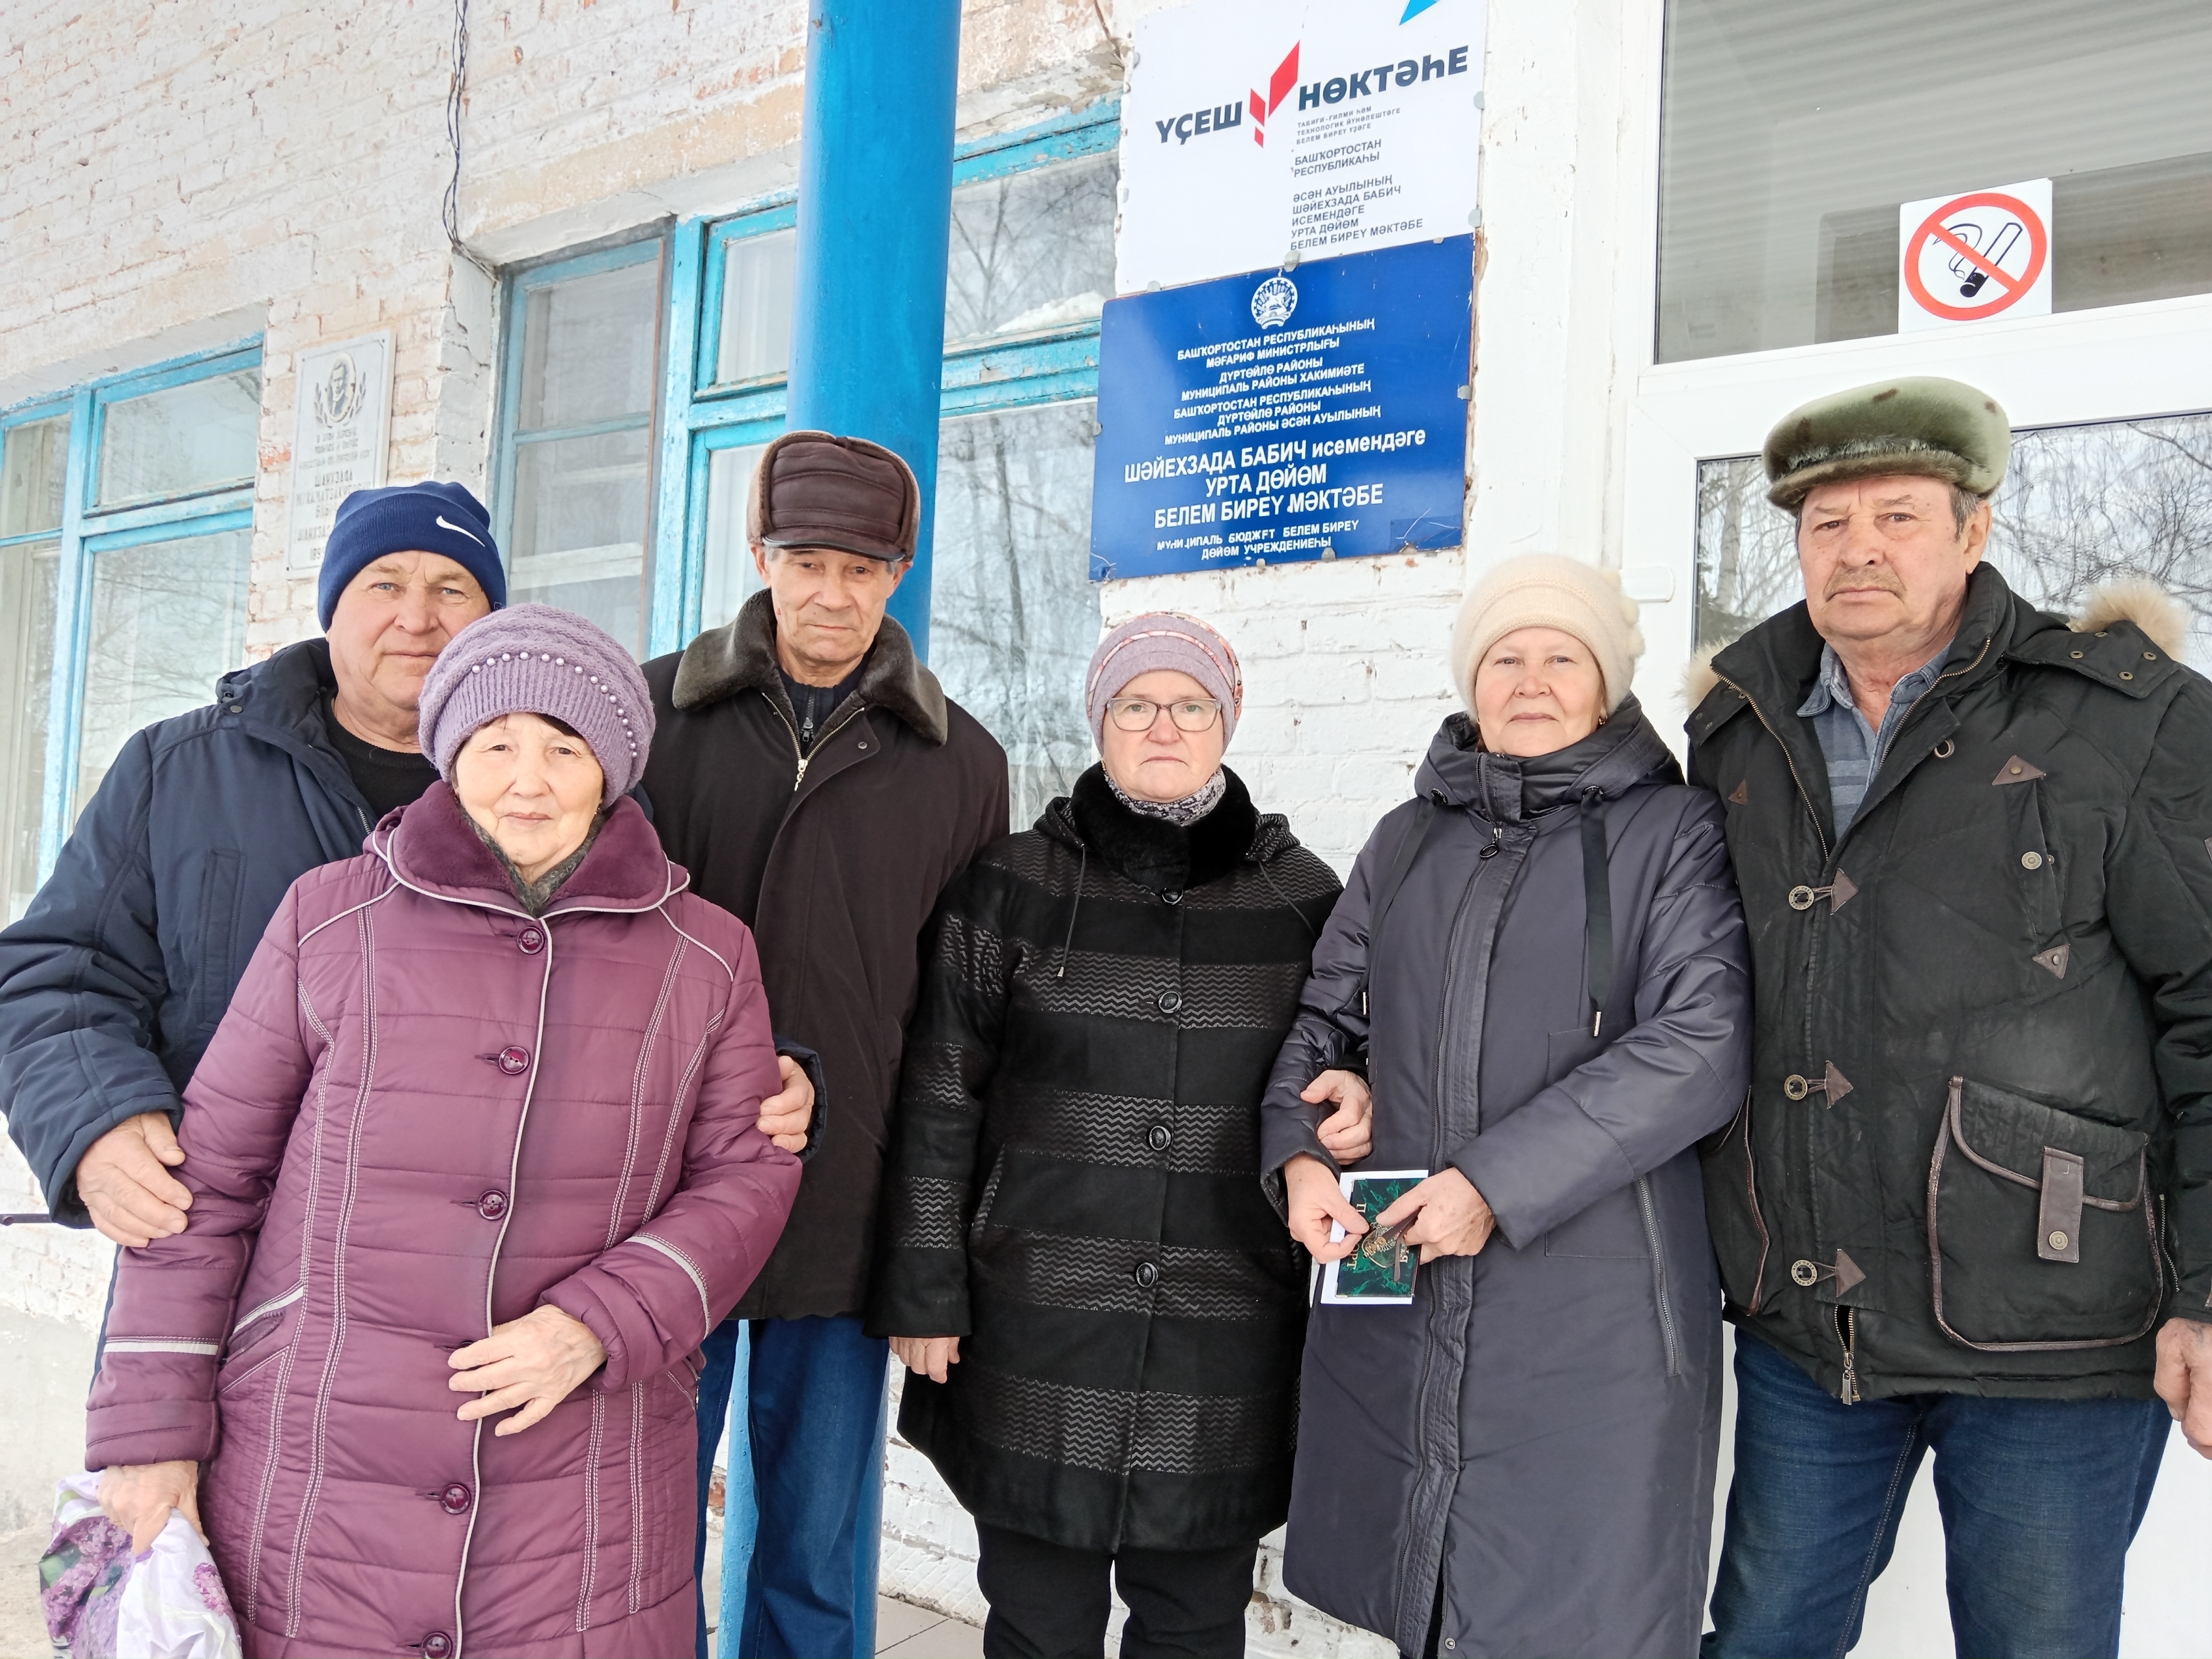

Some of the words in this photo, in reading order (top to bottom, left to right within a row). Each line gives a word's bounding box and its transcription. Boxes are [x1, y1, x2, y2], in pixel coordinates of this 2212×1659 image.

[1297, 121, 1344, 136] ТЕХНОЛОГИК
[1296, 134, 1321, 145] БЕЛЕМ
[1293, 189, 1322, 202] ӘСӘН
[1293, 194, 1360, 214] ШӘЙЕХЗАДА
[1363, 185, 1401, 201] БАБИЧ
[1292, 204, 1365, 226] ИСЕМЕНДӘГЕ
[1290, 236, 1327, 251] БЕЛЕМ
[1370, 218, 1423, 236] МӘКТӘБЕ
[1291, 226, 1316, 239] УРТА
[1319, 218, 1358, 235] ДӨЙӨМ
[1276, 356, 1323, 374] РАЙОНЫ
[1181, 381, 1250, 401] МУНИЦИПАЛЬ
[1252, 373, 1297, 390] РАЙОНЫ
[1274, 400, 1321, 417] РАЙОНЫ
[1164, 427, 1232, 446] МУНИЦИПАЛЬ
[1234, 420, 1279, 436] РАЙОНЫ
[1281, 415, 1311, 429] ӘСӘН
[1123, 450, 1236, 483] ШӘЙЕХЗАДА
[1241, 440, 1307, 467] БАБИЧ
[1312, 429, 1426, 458] исемендәге
[1205, 472, 1252, 498] УРТА
[1255, 463, 1326, 494] ДӨЙӨМ
[1155, 503, 1216, 529] БЕЛЕМ
[1289, 483, 1385, 513] МӘКТӘБЕ
[1283, 524, 1320, 537] БЕЛЕМ
[1201, 545, 1239, 561] ДӨЙӨМ
